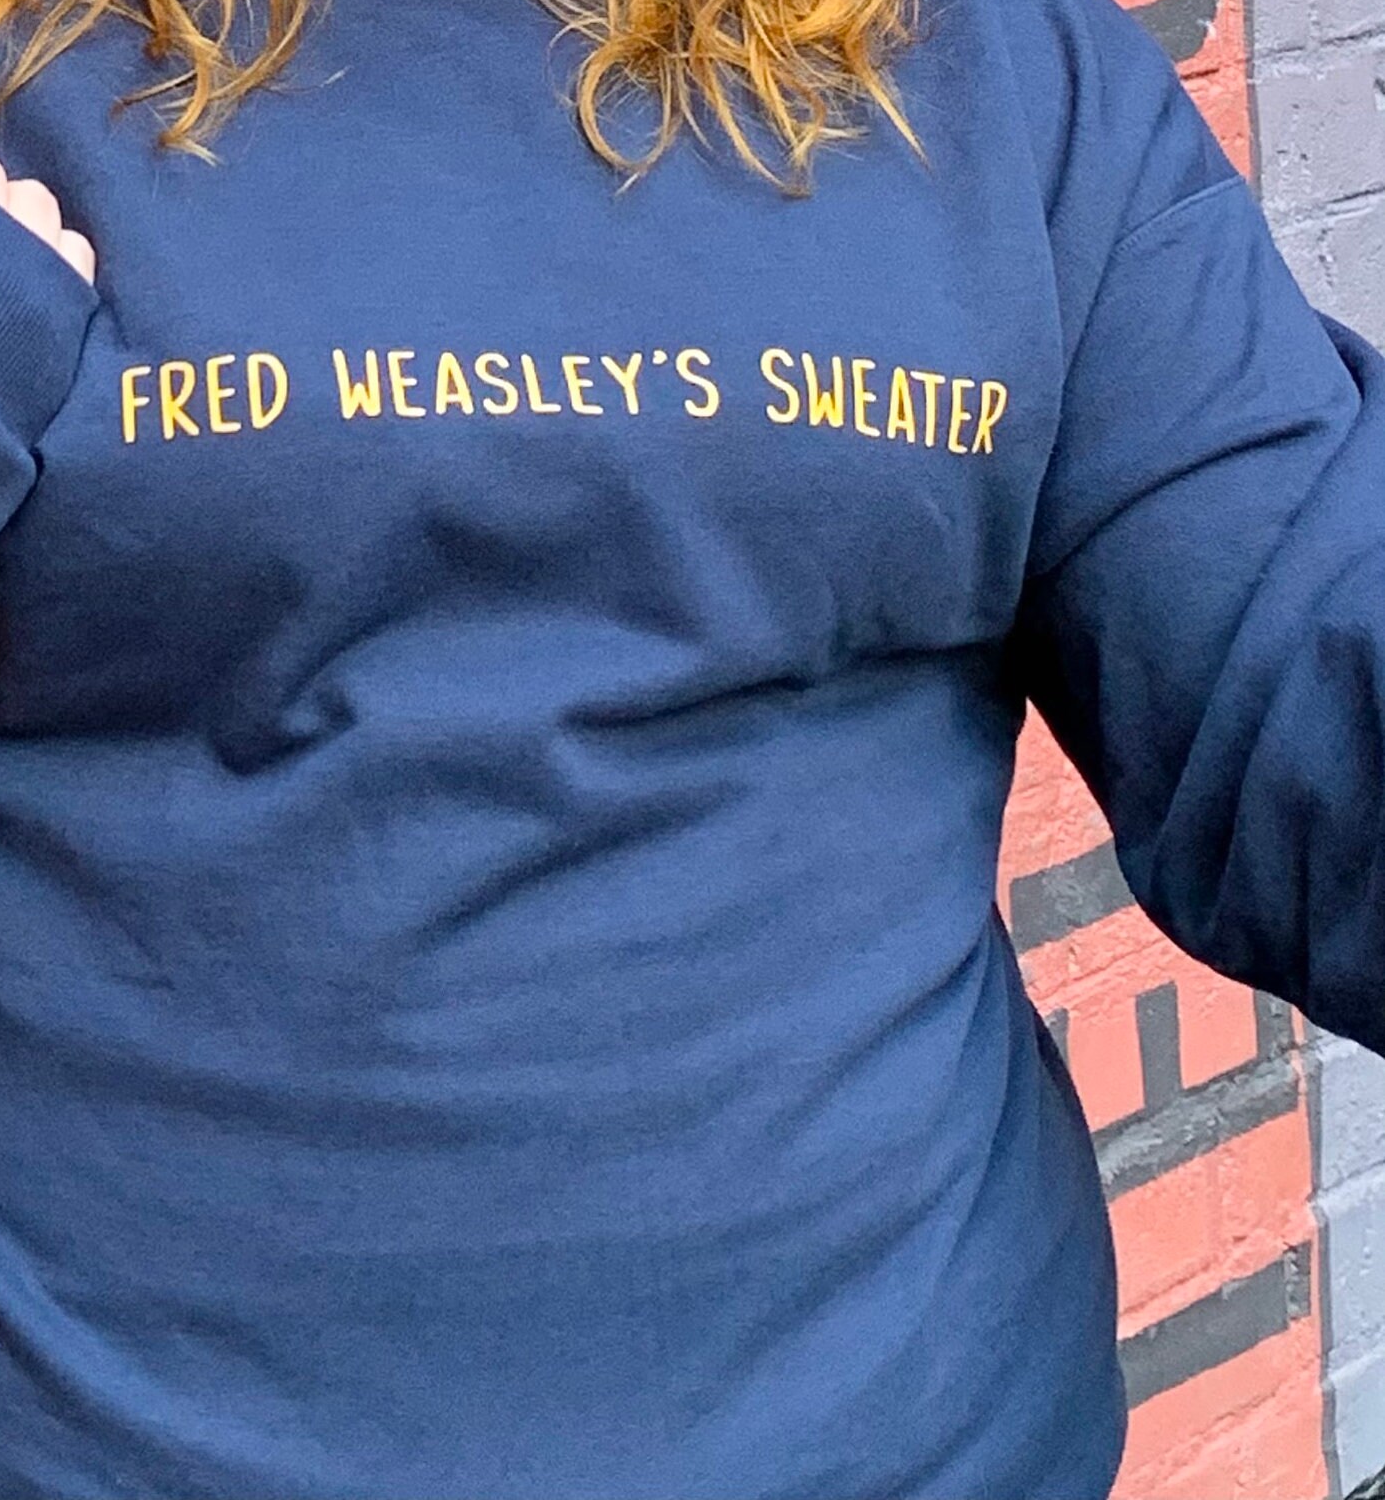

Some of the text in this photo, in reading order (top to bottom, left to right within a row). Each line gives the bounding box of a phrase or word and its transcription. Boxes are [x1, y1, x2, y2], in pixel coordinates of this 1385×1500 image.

[120, 348, 1009, 454] FRED WEASLEY'S SWEATER
